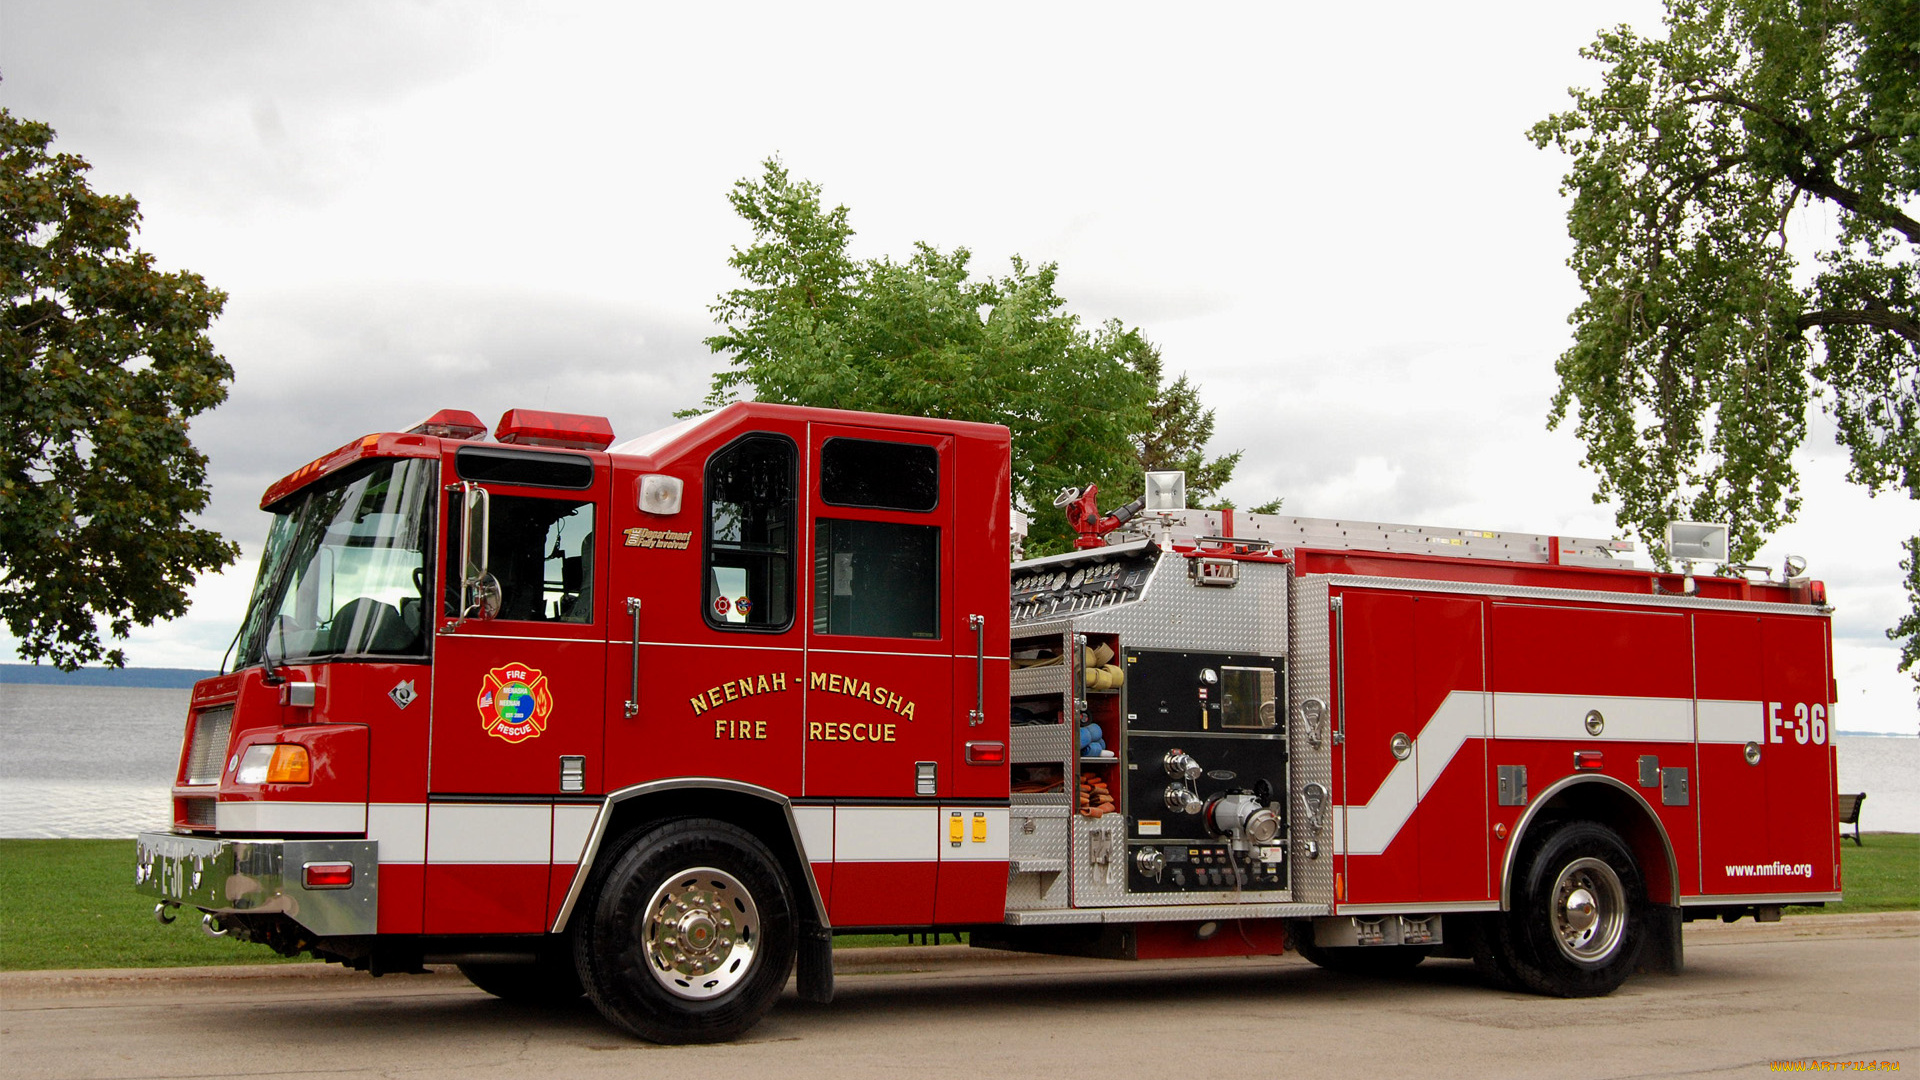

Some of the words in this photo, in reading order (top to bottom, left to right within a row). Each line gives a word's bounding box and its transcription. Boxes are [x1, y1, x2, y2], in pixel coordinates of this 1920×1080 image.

[641, 528, 692, 540] Department
[639, 539, 656, 549] Fully
[657, 540, 689, 549] Involved
[506, 670, 527, 680] FIRE
[690, 672, 787, 717] NEENAH
[810, 671, 916, 721] MENASHA
[499, 699, 520, 707] NEENAH
[497, 723, 532, 736] RESCUE
[1769, 701, 1826, 746] E-36
[714, 719, 767, 740] FIRE
[809, 721, 896, 742] RESCUE
[1725, 861, 1812, 878] www.nmfire.org
